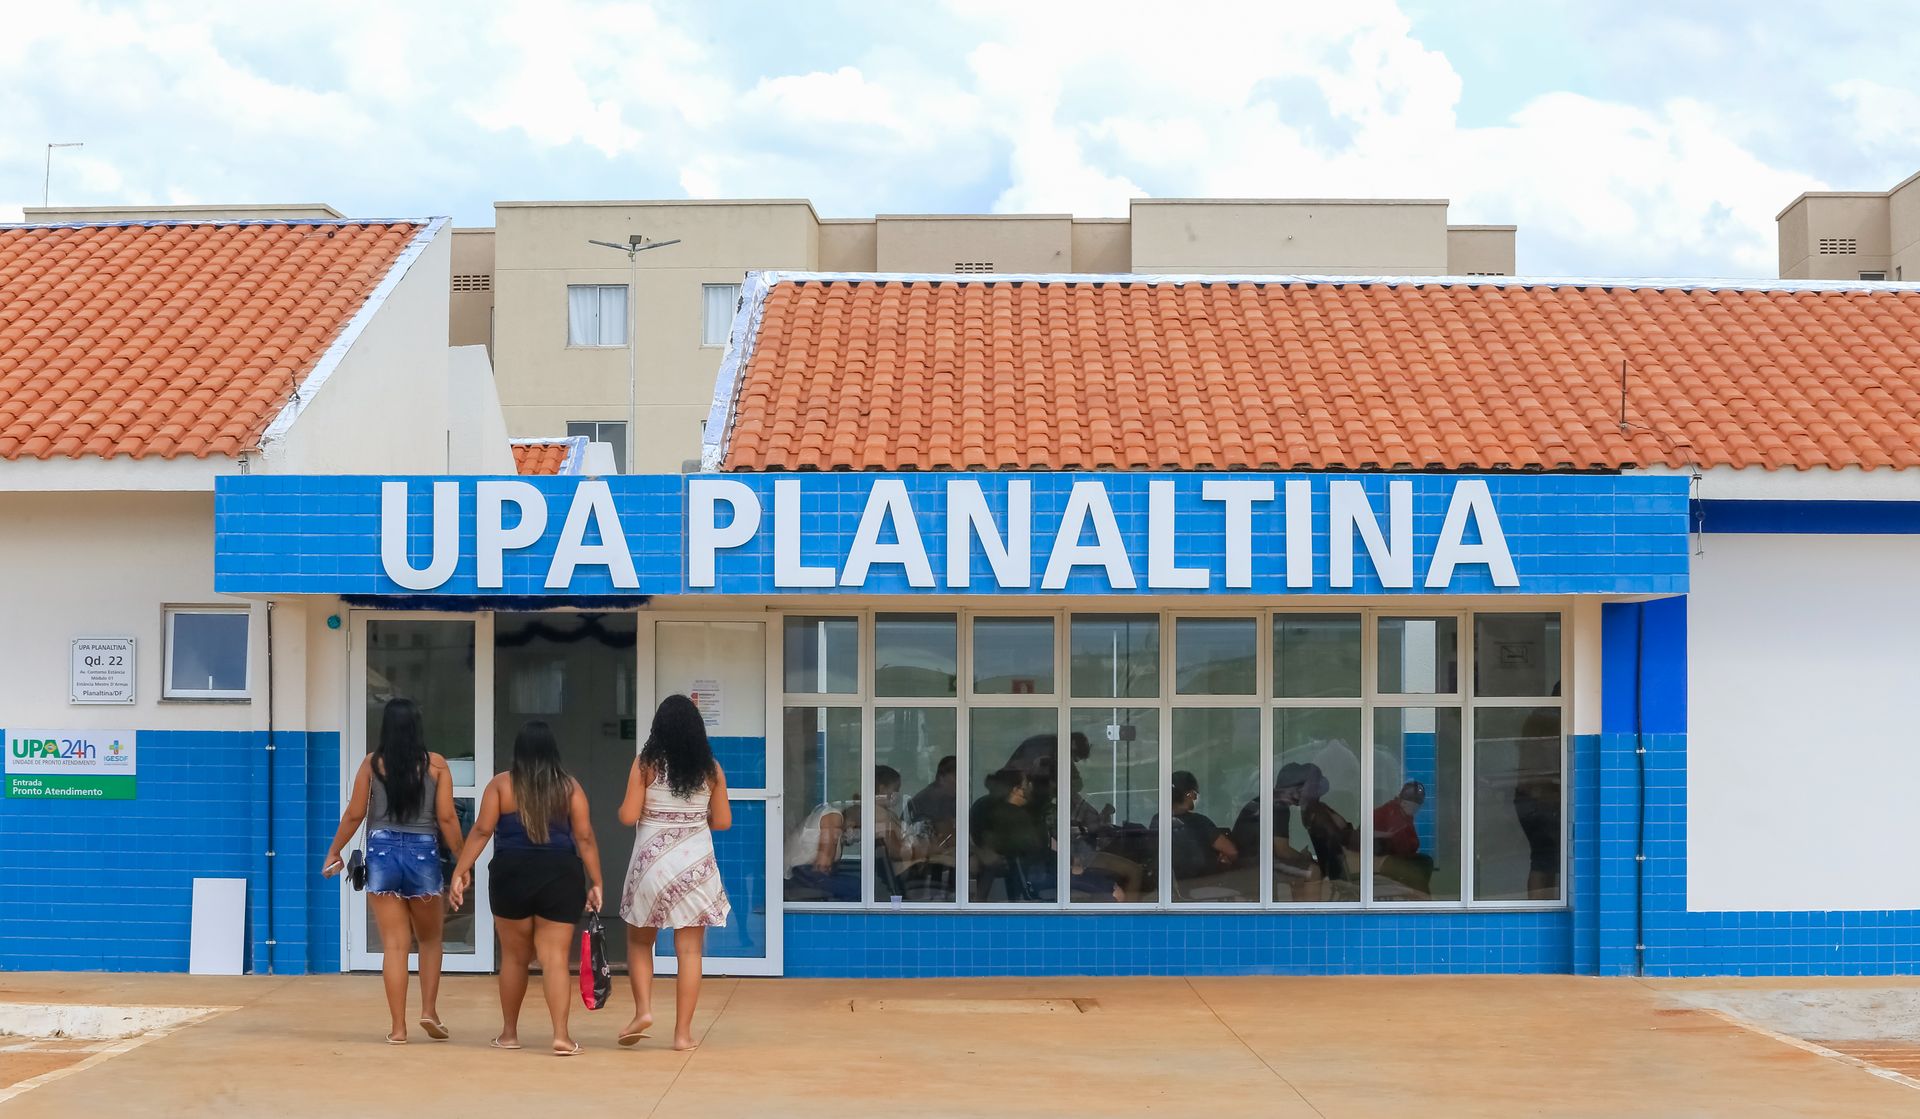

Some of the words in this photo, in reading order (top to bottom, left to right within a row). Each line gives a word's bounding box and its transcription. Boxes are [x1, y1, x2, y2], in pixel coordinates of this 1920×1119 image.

[380, 480, 640, 591] UPA
[687, 479, 1521, 590] PLANALTINA
[84, 656, 104, 667] Qd.
[109, 656, 123, 666] 22
[12, 787, 42, 795] Pronto
[45, 787, 103, 796] Atendimento
